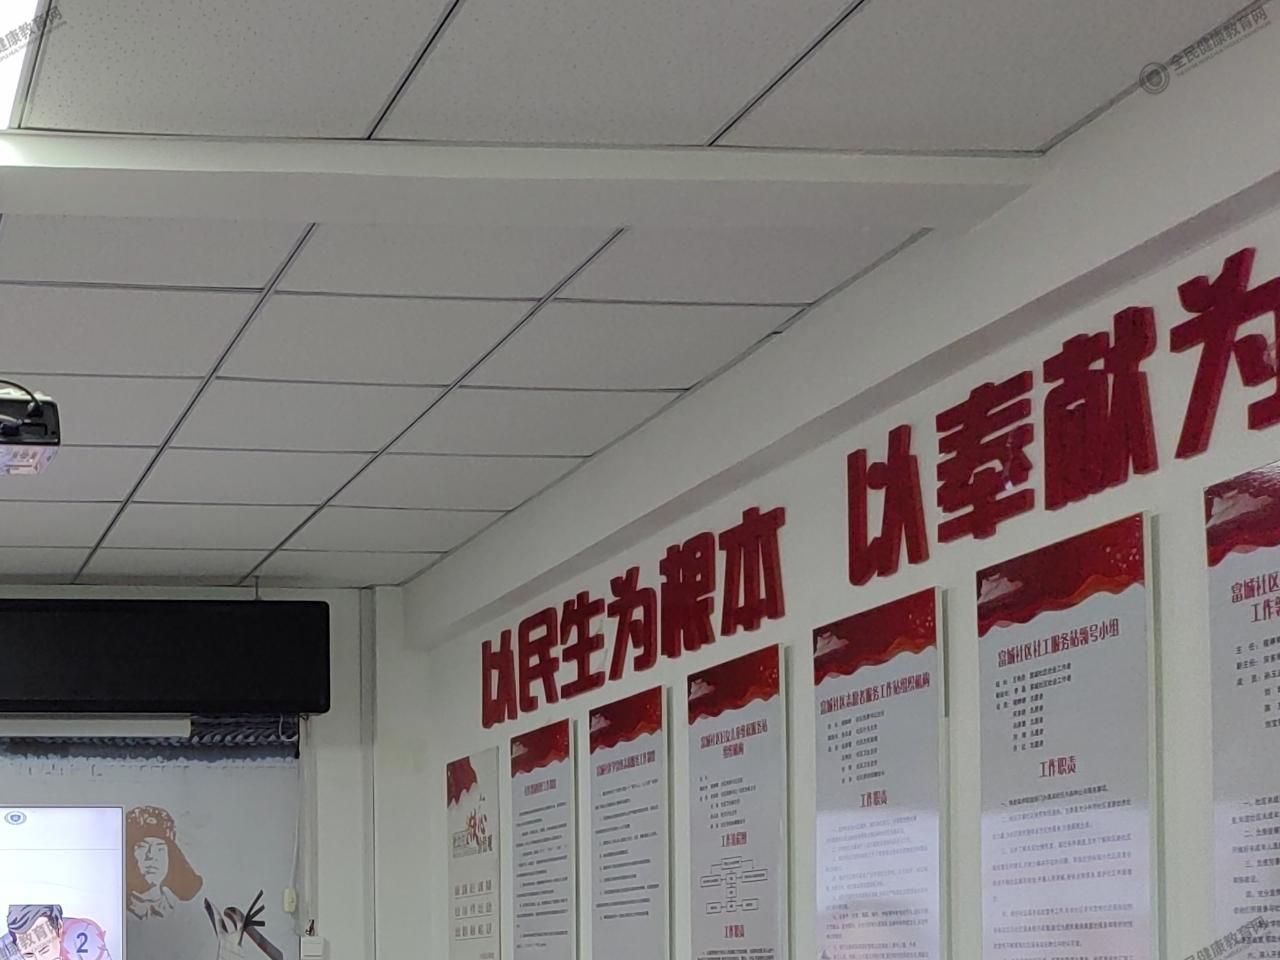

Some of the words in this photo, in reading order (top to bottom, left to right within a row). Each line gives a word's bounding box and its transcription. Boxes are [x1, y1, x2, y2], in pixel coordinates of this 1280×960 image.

[482, 506, 785, 729] 以民生为根本
[848, 247, 1280, 586] 以奉献为
[1039, 755, 1077, 778] 工作职责
[76, 932, 89, 953] 2
